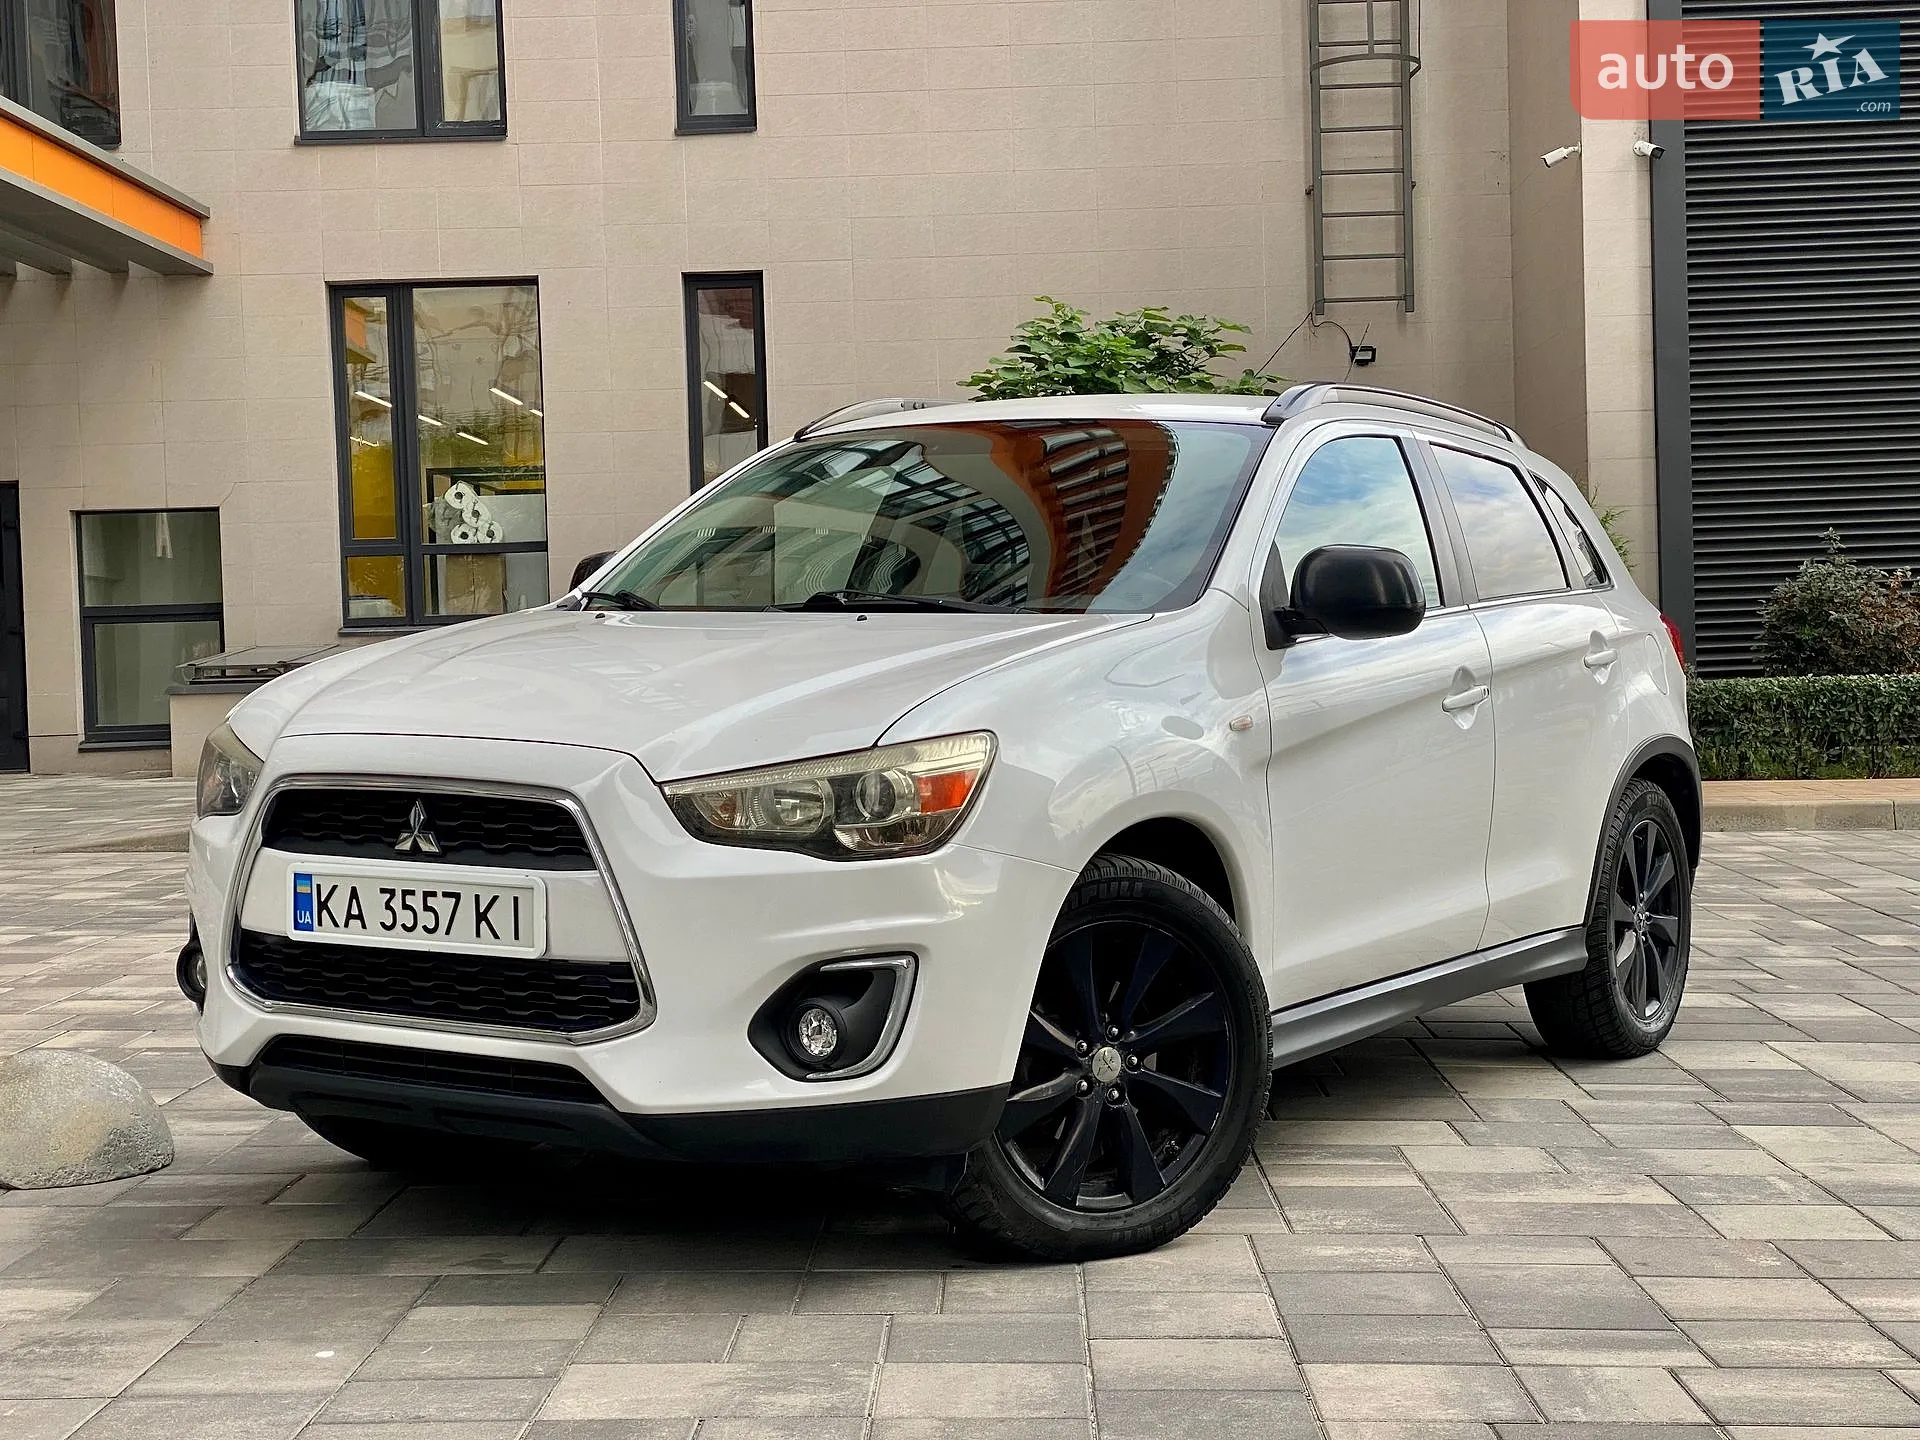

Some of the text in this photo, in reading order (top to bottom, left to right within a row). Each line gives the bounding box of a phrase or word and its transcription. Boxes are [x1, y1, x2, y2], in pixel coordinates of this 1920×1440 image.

[296, 909, 313, 925] UA
[315, 883, 520, 941] KA 3557 KI
